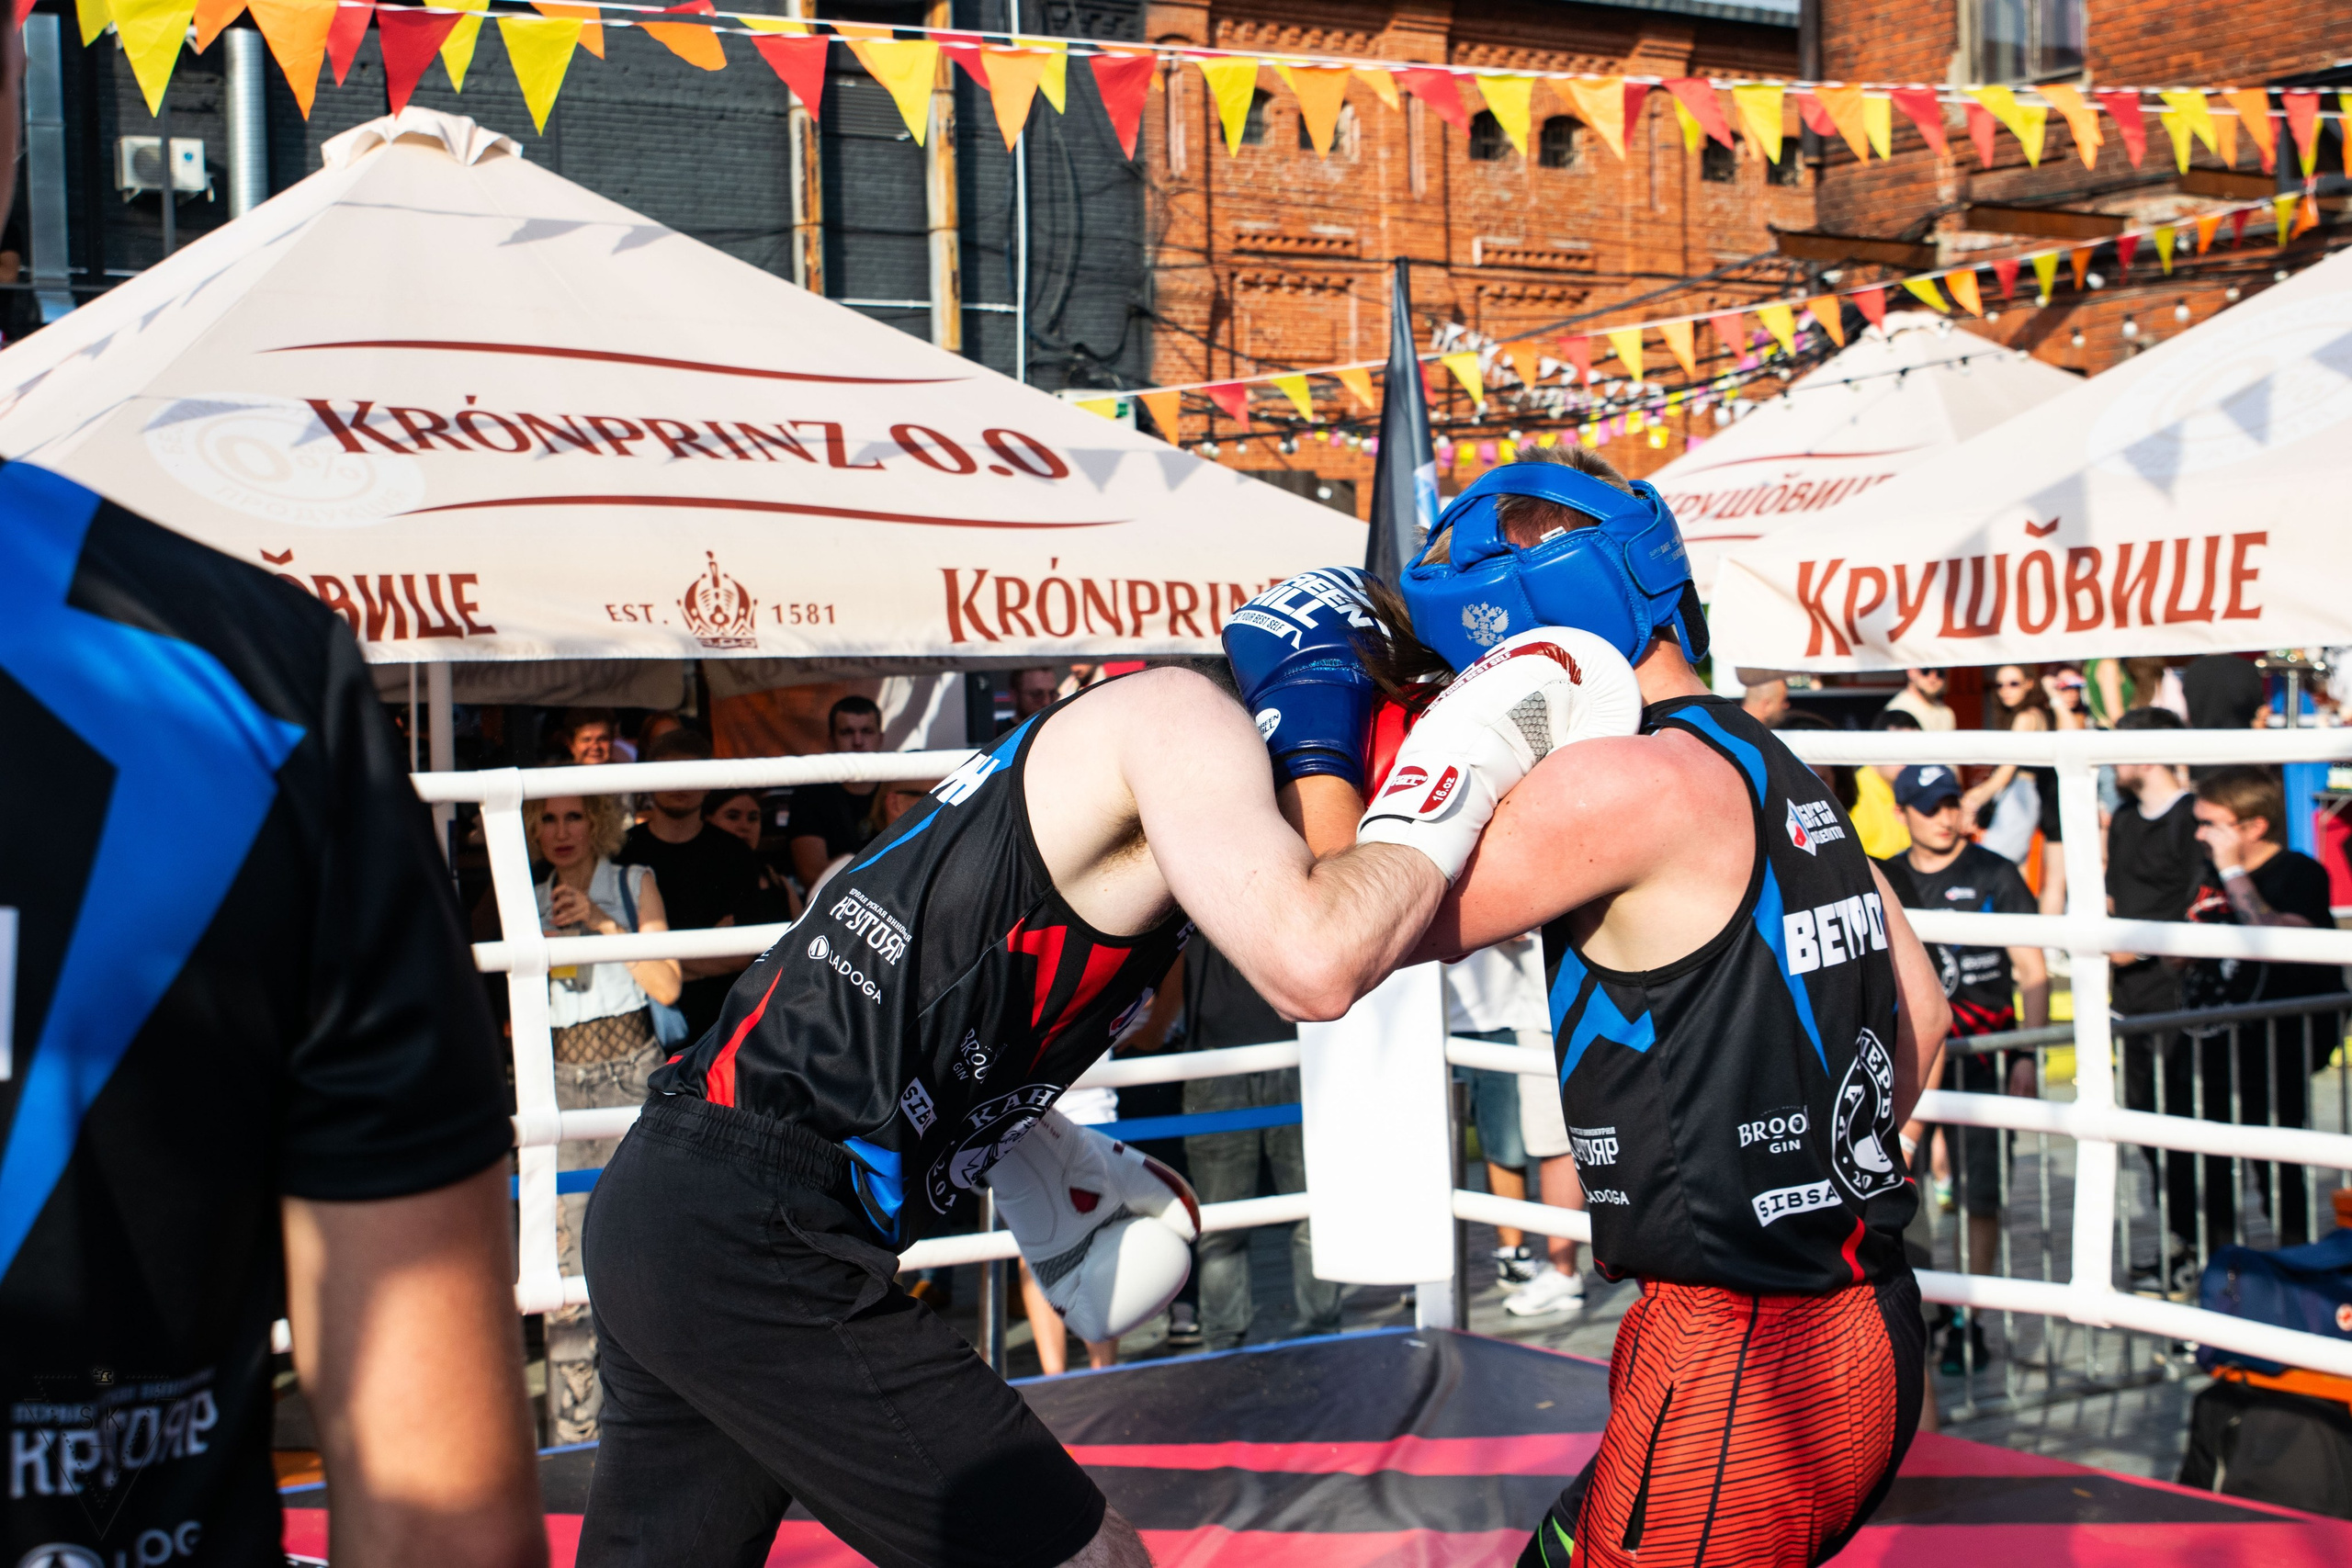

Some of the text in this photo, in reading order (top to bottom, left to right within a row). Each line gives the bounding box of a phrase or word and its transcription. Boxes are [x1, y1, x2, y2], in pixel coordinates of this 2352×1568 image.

[1272, 573, 1374, 628] REEN
[605, 604, 669, 625] EST.
[771, 604, 835, 625] 1581
[1252, 614, 1270, 626] BEST
[1267, 619, 1284, 631] SELF
[1441, 678, 1467, 699] YOUR
[1465, 664, 1489, 682] BEST
[1487, 651, 1511, 668] SELF
[828, 949, 881, 1005] LADOGA
[953, 1062, 969, 1081] GIN
[1769, 1139, 1802, 1154] GIN
